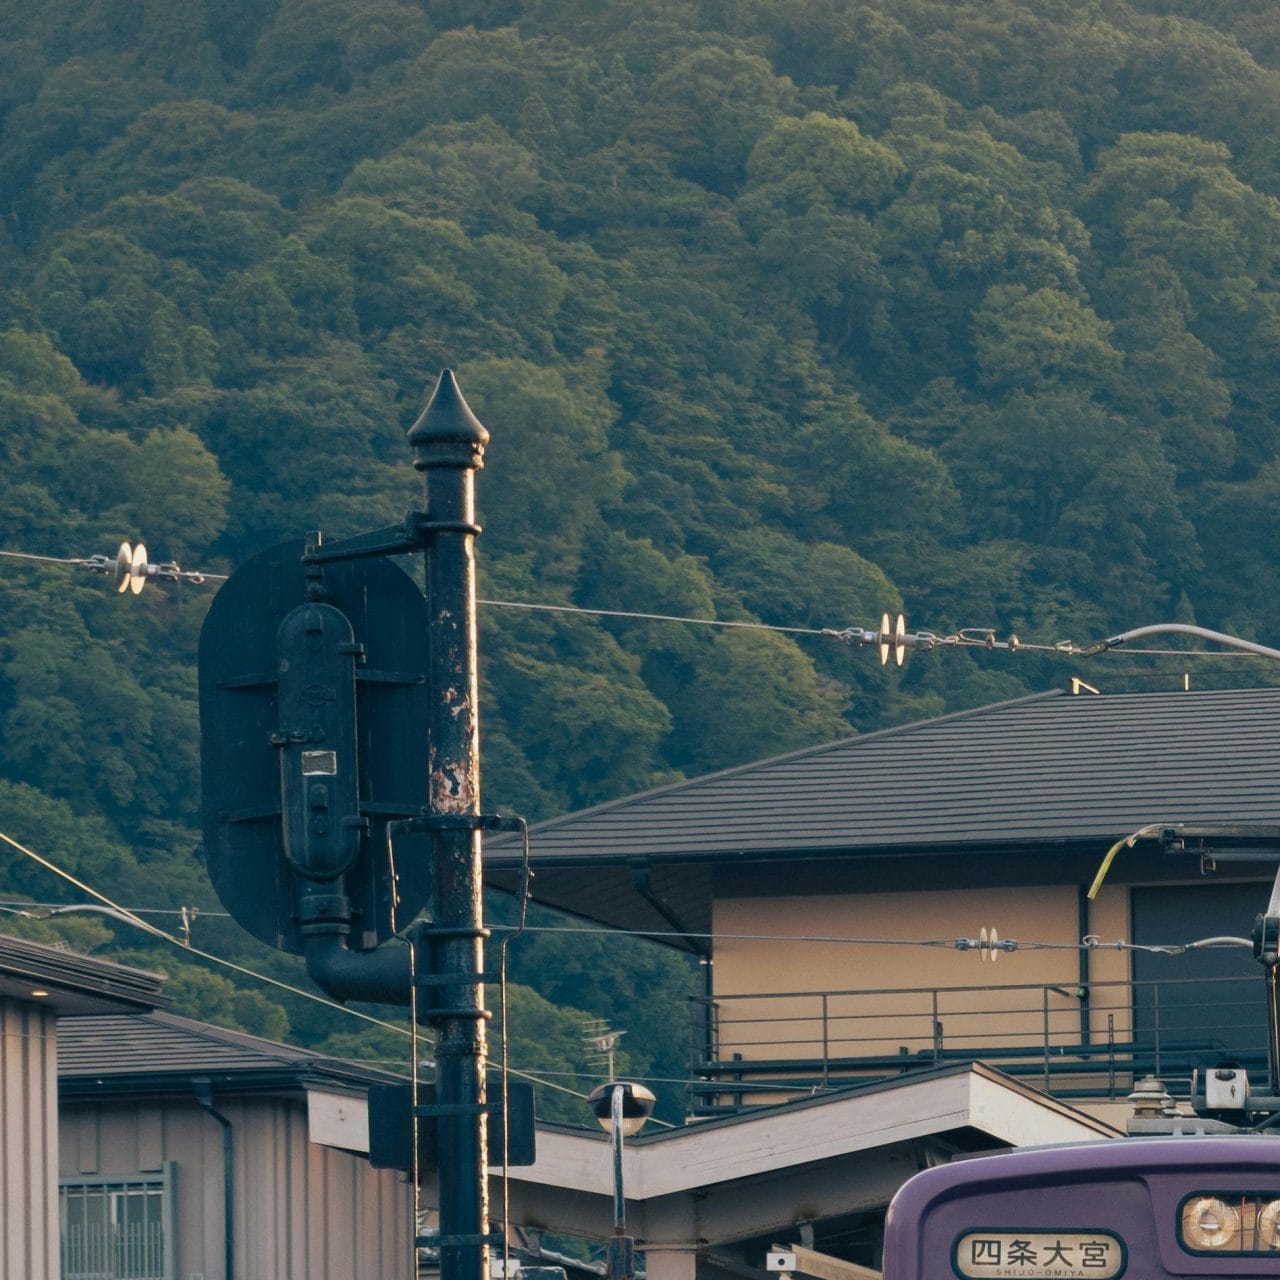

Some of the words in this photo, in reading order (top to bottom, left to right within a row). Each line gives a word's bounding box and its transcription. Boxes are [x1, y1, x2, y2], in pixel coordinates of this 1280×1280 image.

[972, 1239, 1110, 1268] 四条大宮
[996, 1268, 1084, 1277] SHIJO-OMIYA
